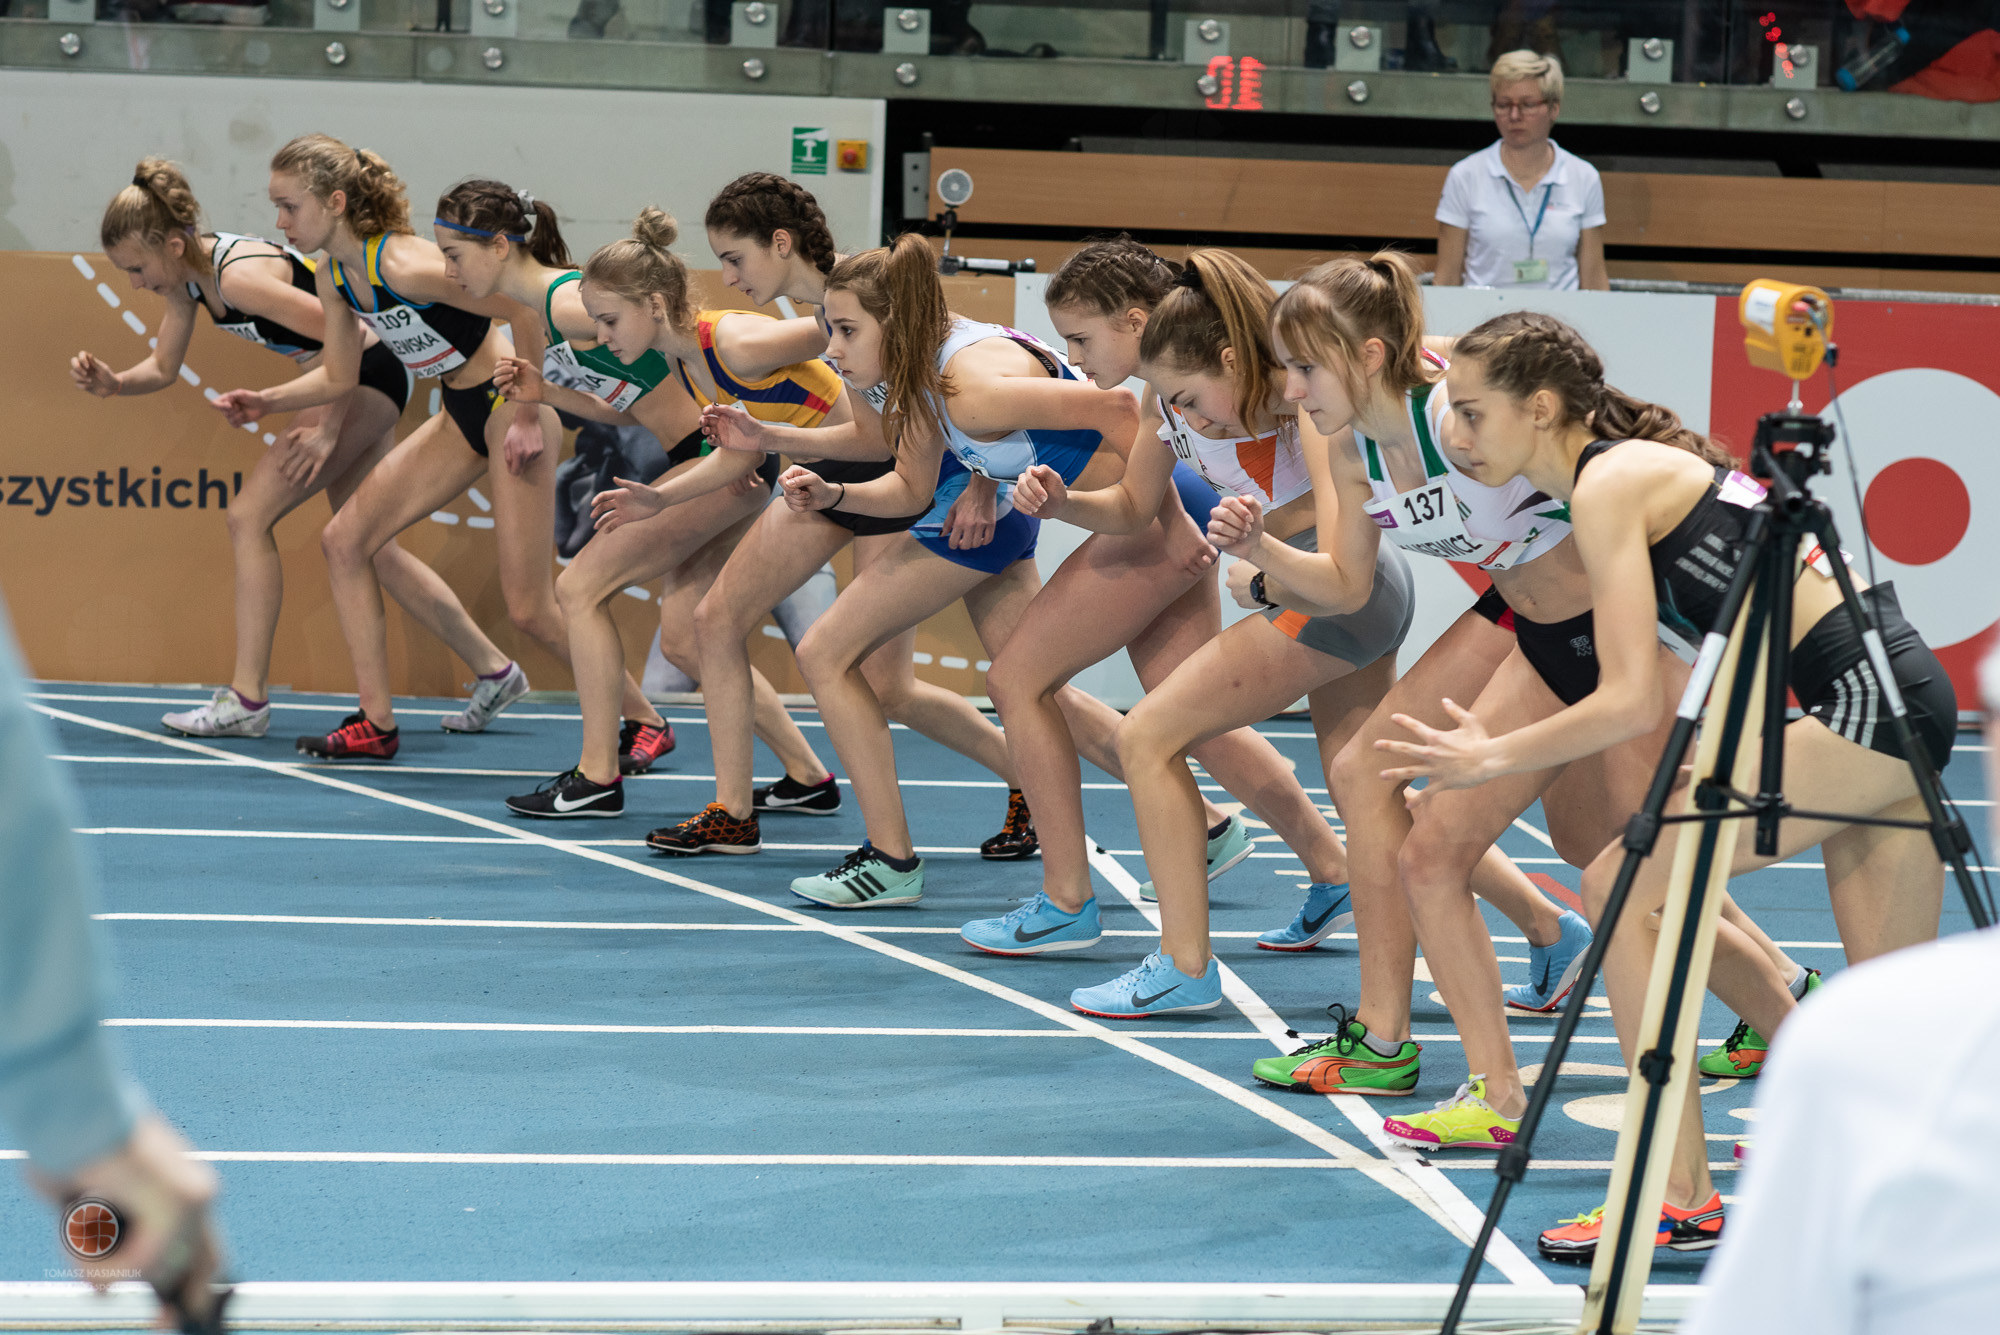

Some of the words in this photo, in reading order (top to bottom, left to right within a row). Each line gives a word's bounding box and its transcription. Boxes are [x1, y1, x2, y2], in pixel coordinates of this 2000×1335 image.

[377, 309, 411, 330] 109
[0, 466, 242, 517] zystkich!
[1403, 486, 1445, 526] 137
